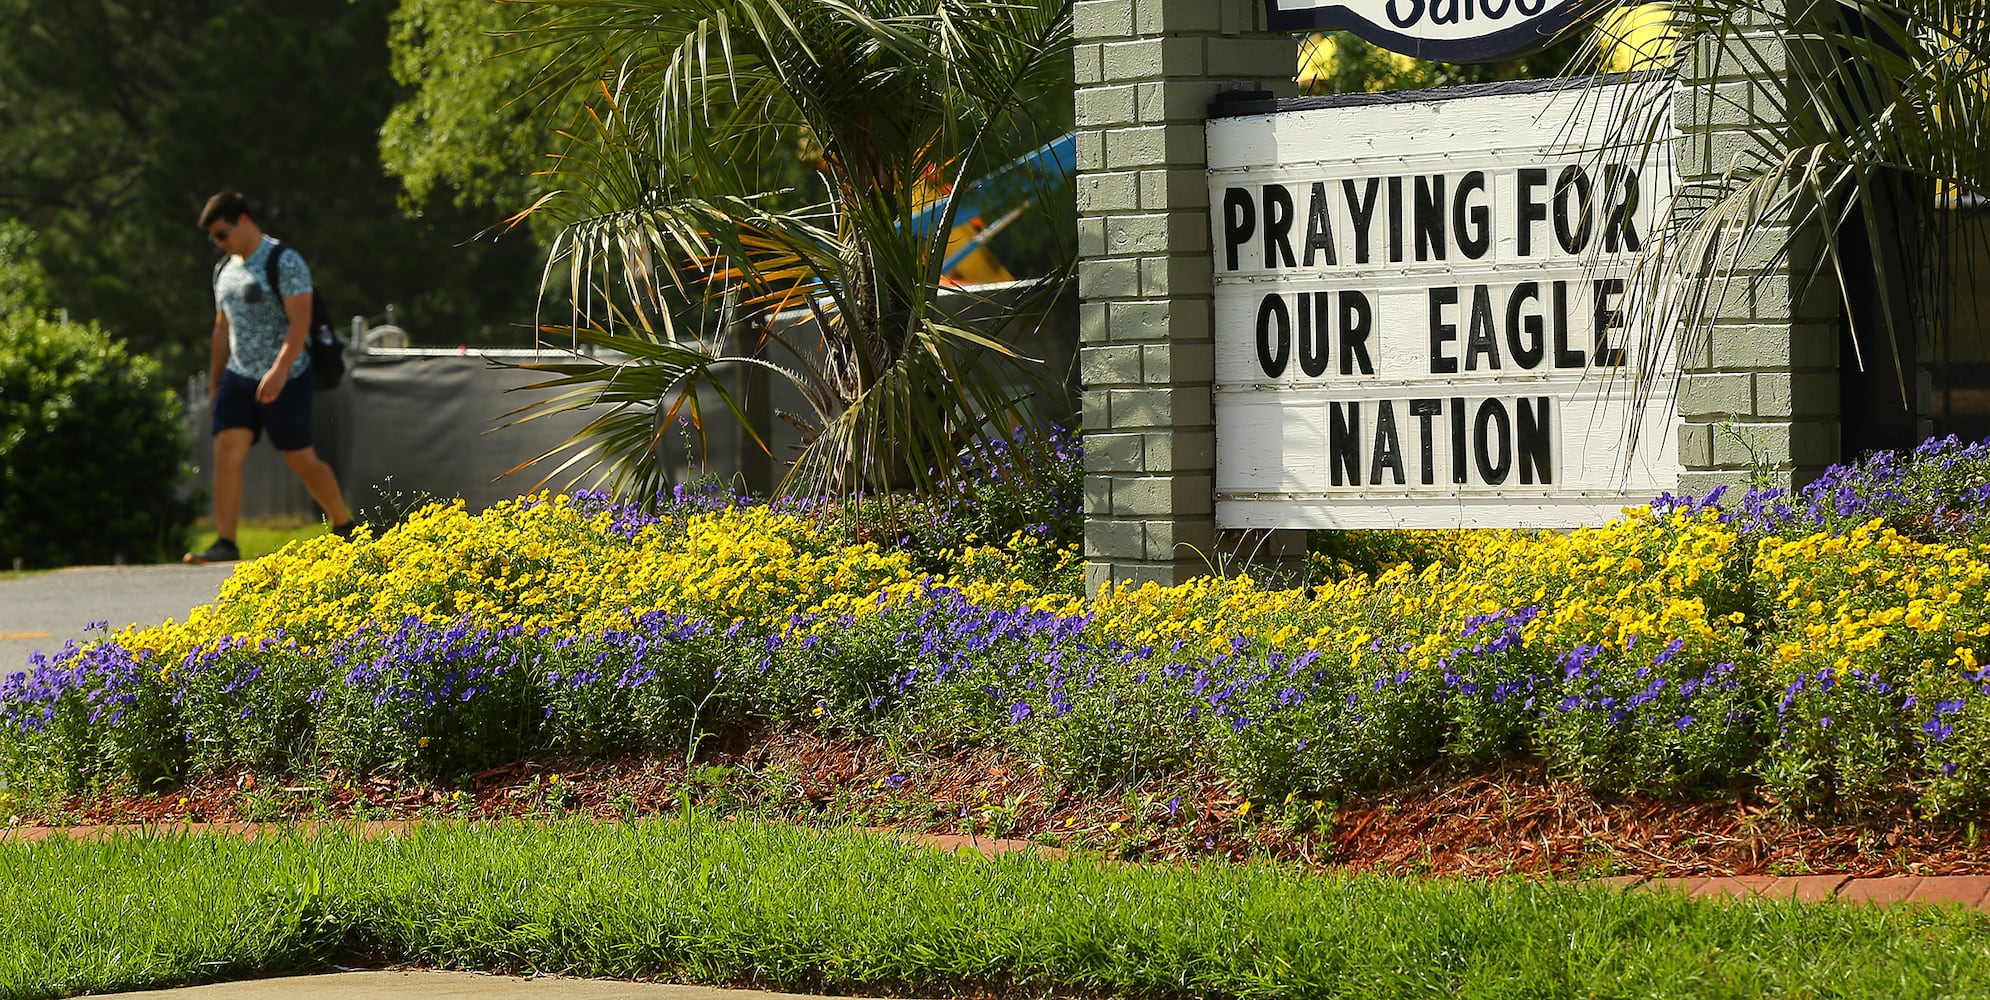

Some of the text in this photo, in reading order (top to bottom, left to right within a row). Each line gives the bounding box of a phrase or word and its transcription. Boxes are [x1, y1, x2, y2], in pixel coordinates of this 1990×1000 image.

[1223, 164, 1641, 271] PRAYING FOR
[1256, 278, 1627, 378] OUR EAGLE
[1329, 396, 1552, 486] NATION
